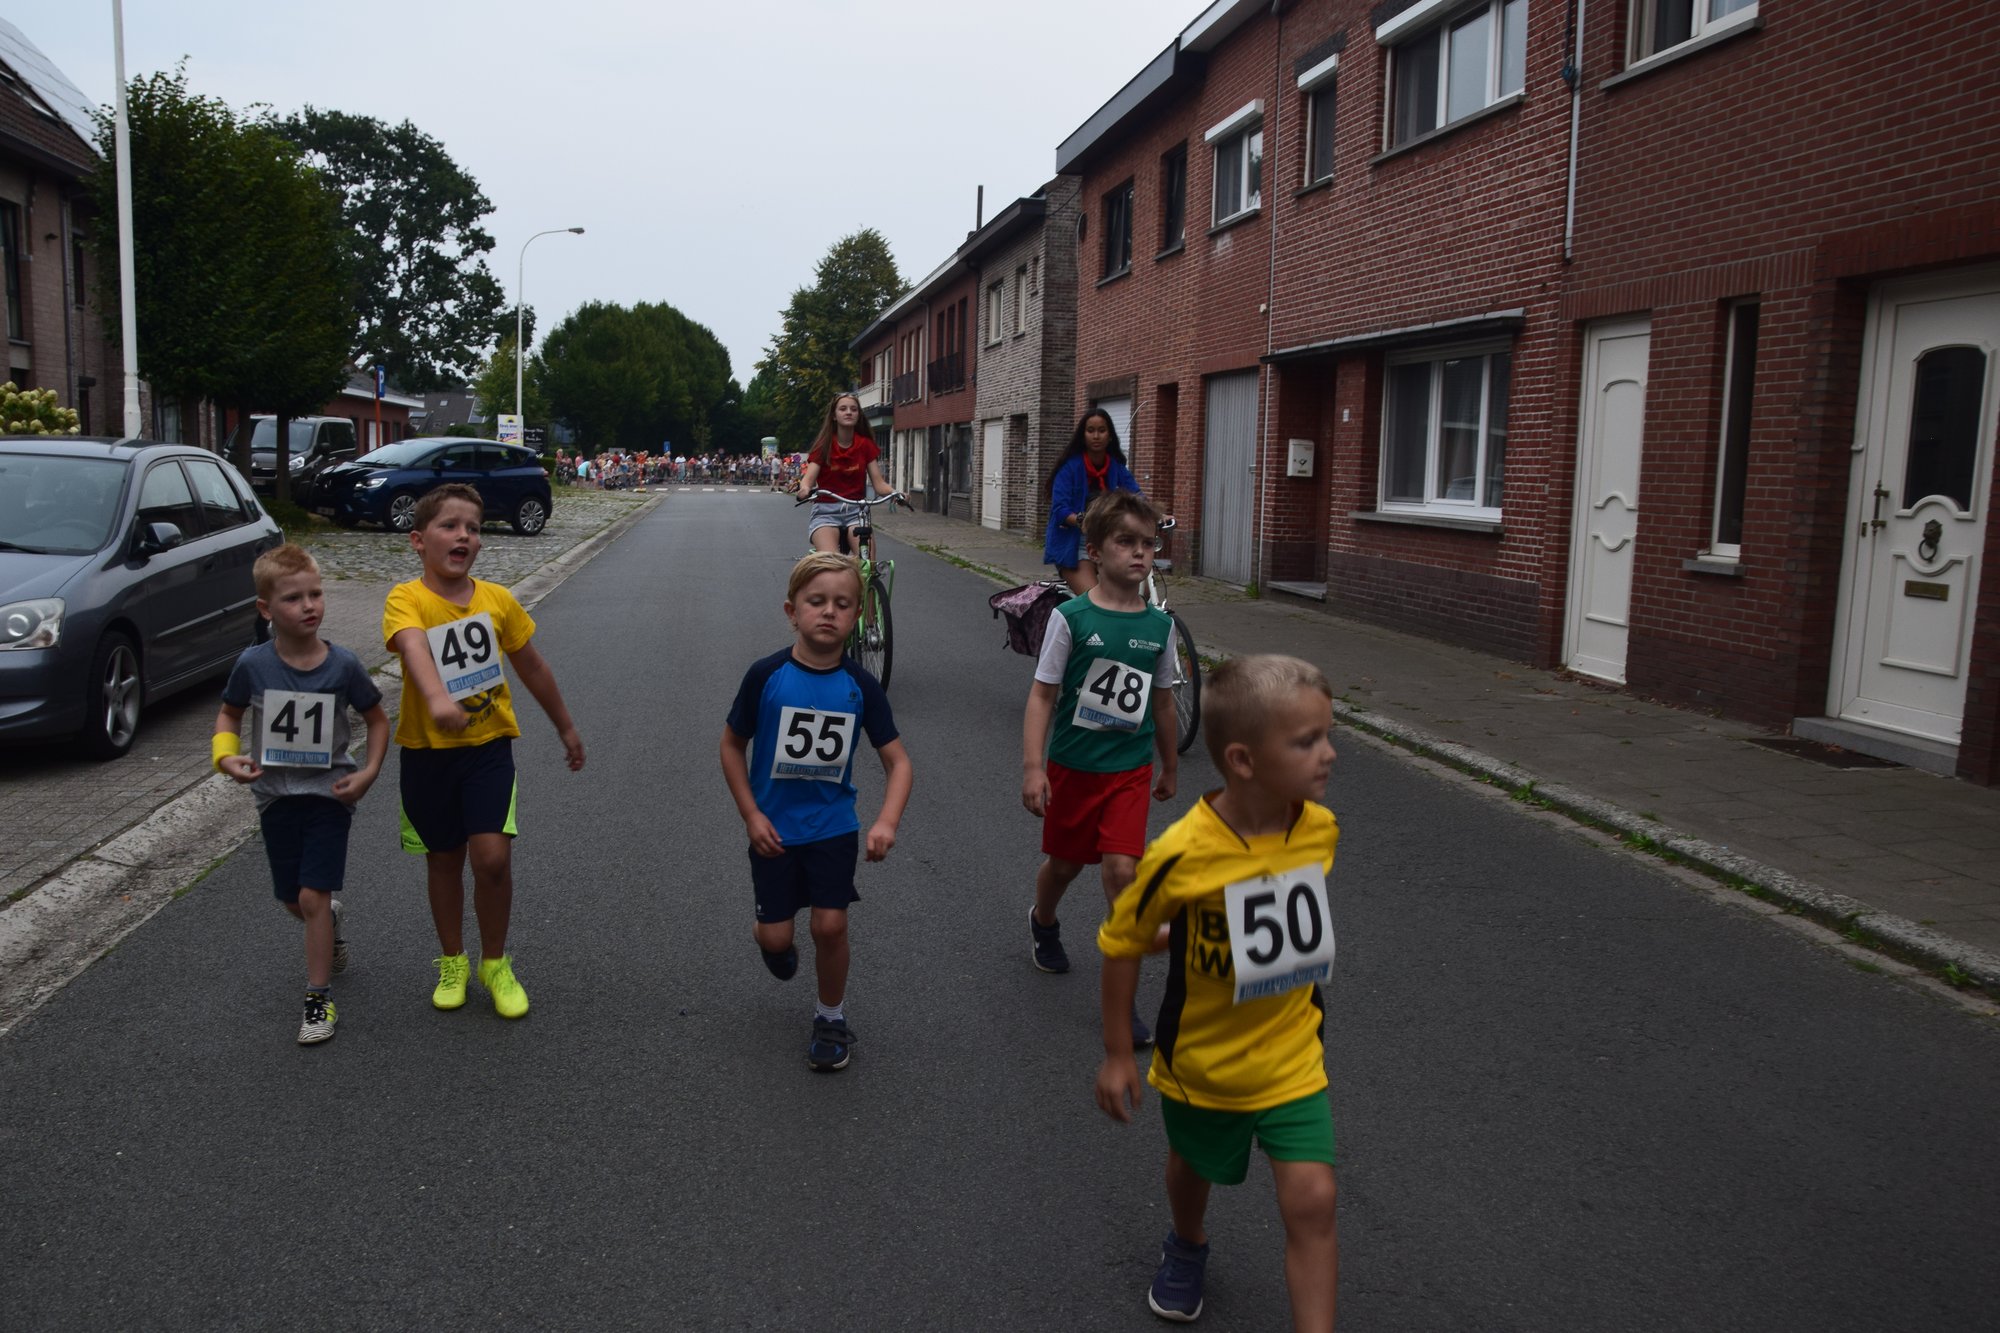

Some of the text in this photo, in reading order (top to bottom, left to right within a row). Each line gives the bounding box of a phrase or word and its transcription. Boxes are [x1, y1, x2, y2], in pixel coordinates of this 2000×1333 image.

[441, 621, 491, 670] 49
[449, 679, 462, 692] HET
[1089, 665, 1143, 713] 48
[270, 700, 323, 744] 41
[785, 712, 846, 762] 55
[268, 749, 280, 761] HET
[1244, 882, 1322, 966] 50
